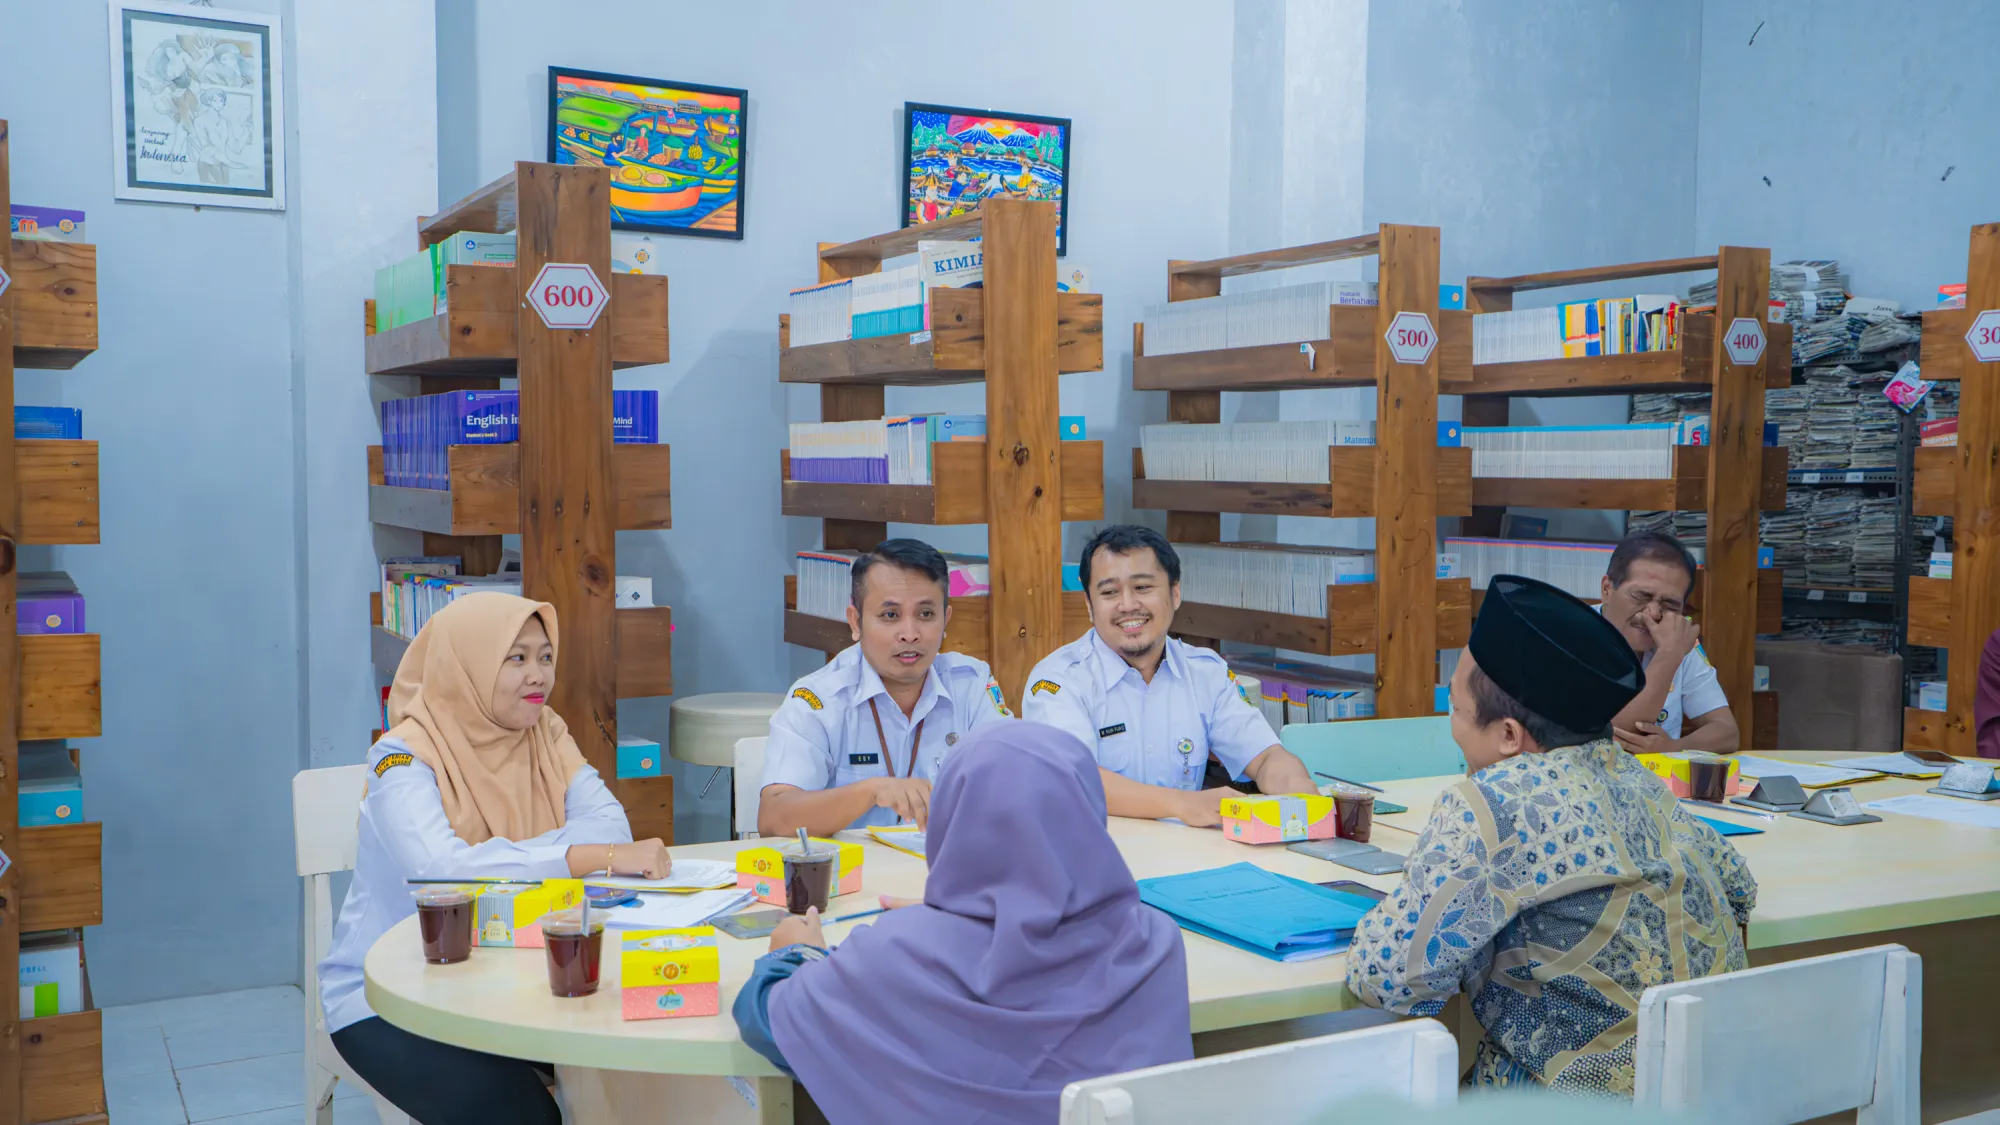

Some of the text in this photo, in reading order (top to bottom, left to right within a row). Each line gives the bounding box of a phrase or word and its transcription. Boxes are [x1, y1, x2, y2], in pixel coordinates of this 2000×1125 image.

[140, 145, 189, 163] Indonesia
[543, 285, 594, 308] 600
[1397, 328, 1429, 348] 500
[1733, 333, 1759, 350] 400
[466, 414, 508, 429] English
[613, 416, 633, 425] Mind
